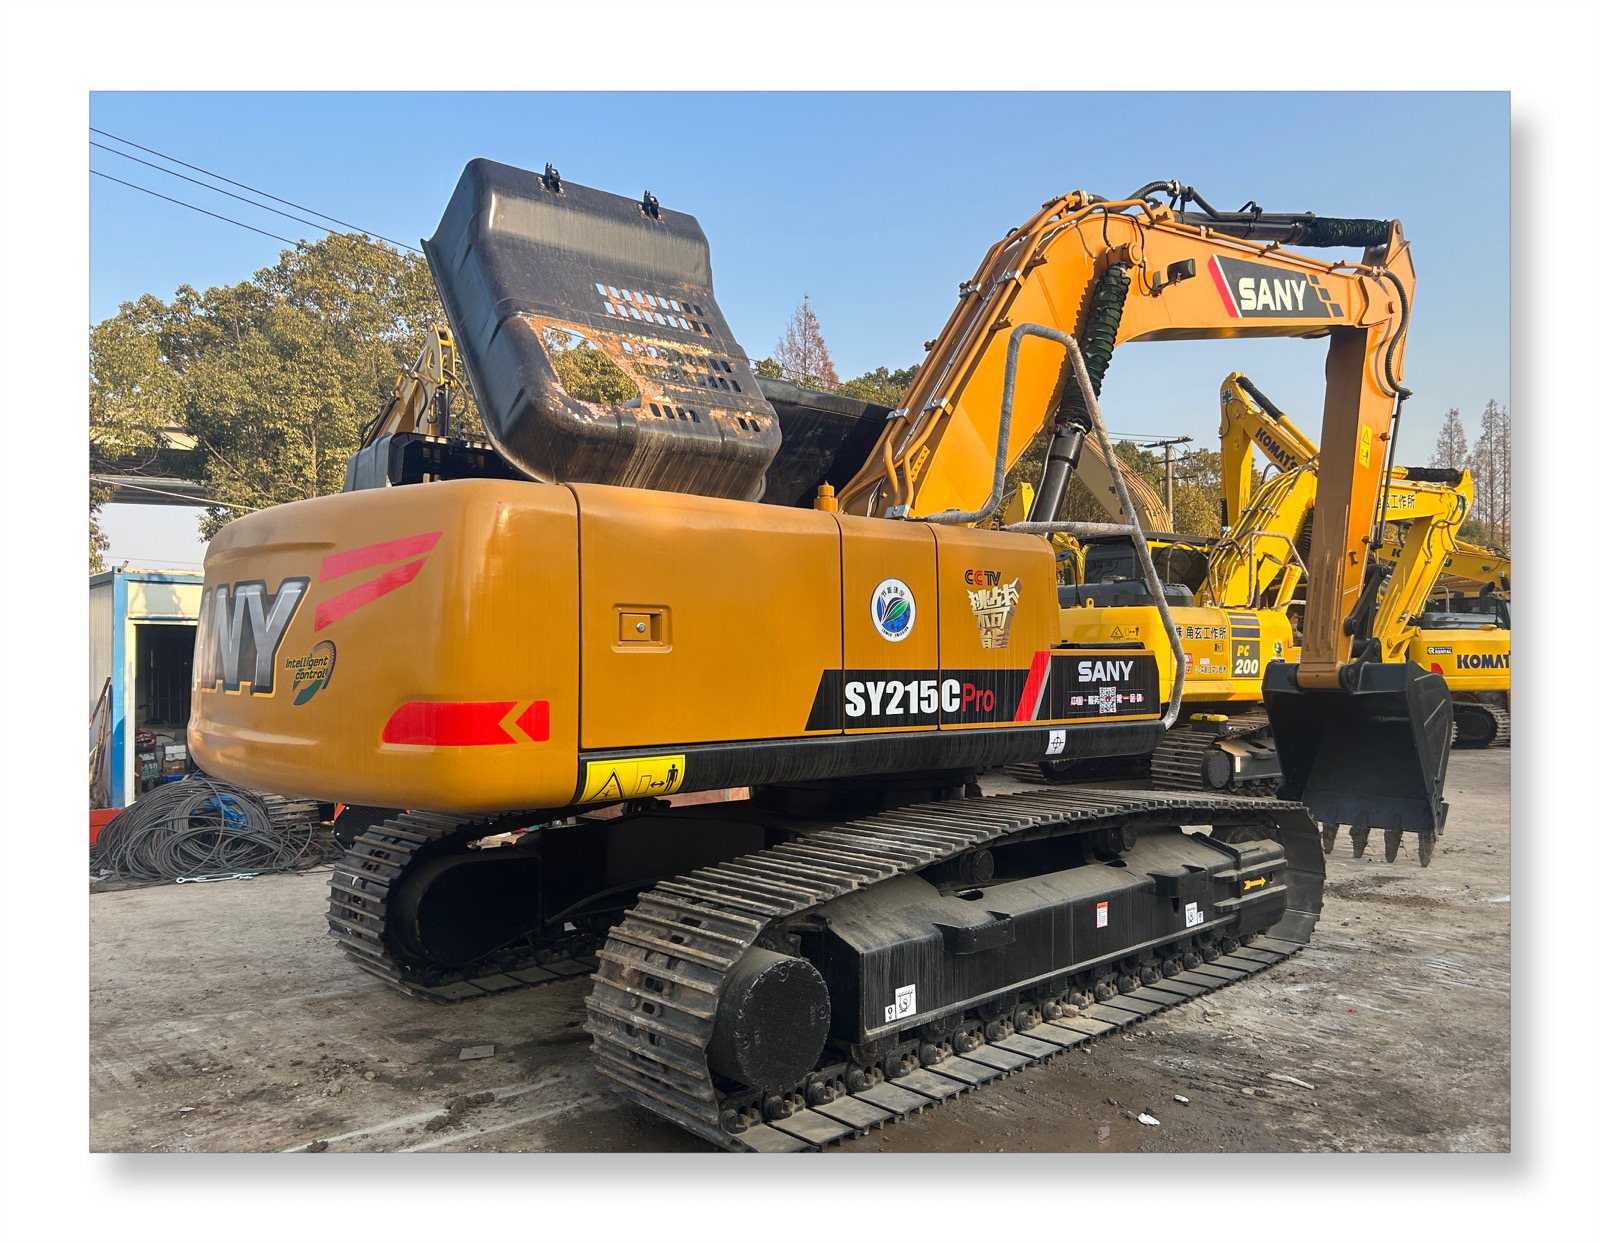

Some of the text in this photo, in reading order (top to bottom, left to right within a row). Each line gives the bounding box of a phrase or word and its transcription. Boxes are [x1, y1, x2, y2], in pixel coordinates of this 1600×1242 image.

[1238, 277, 1307, 311] SANY
[1254, 426, 1299, 471] KOMATS
[964, 569, 1002, 586] CCTV
[1236, 645, 1250, 657] PC
[285, 655, 329, 669] Intelligent
[1234, 658, 1259, 675] 200
[1077, 660, 1135, 682] SANY
